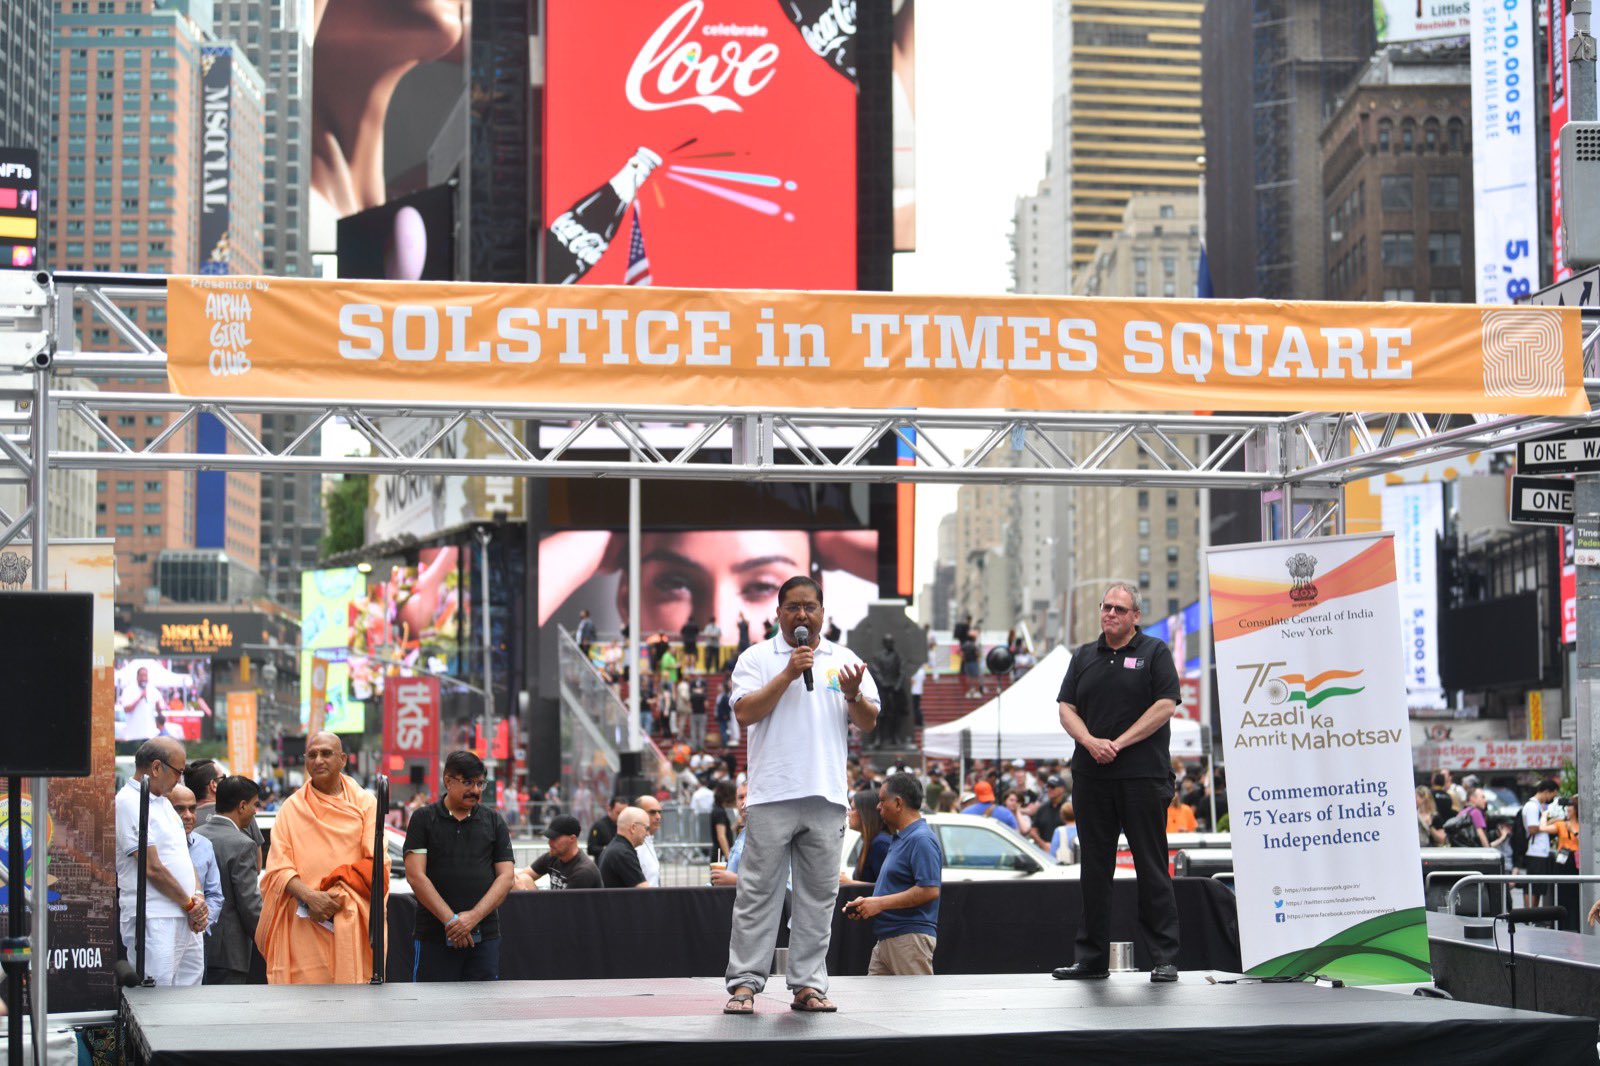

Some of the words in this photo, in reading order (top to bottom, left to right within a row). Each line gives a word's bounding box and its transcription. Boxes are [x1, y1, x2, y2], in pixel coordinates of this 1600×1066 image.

[702, 23, 768, 37] celebrate
[1483, 7, 1497, 52] SPACE
[625, 0, 779, 114] love
[1485, 59, 1500, 139] AVAILABLE
[1506, 110, 1521, 136] SF
[191, 278, 252, 290] Presented
[255, 280, 270, 292] by
[205, 292, 252, 323] ALPHA
[209, 322, 252, 352] GIRL
[338, 303, 732, 365] SOLSTICE
[756, 308, 830, 368] in
[851, 313, 1098, 371] TIMES
[1123, 320, 1413, 383] SQUARE
[208, 349, 252, 376] CLUB
[1534, 442, 1567, 461] ONE
[1583, 440, 1600, 458] W
[1533, 491, 1573, 511] ONE
[1239, 615, 1290, 629] Consulate
[1291, 612, 1332, 625] General
[1334, 610, 1346, 621] of
[1347, 608, 1374, 620] India
[1281, 629, 1306, 640] New
[1308, 626, 1333, 637] York
[1415, 666, 1426, 684] SF
[397, 682, 431, 750] tkts
[1240, 706, 1305, 729] Azadi
[1311, 714, 1334, 729] Ka
[1234, 730, 1287, 748] Amrit
[1291, 729, 1402, 751] Mahotsav
[1248, 778, 1388, 802] Commemorating
[1243, 811, 1262, 826] 75
[1266, 808, 1311, 825] Years
[1316, 805, 1334, 822] of
[1338, 801, 1395, 820] India's
[1263, 828, 1380, 851] Independence
[54, 948, 69, 969] OF
[71, 947, 102, 969] YOGA
